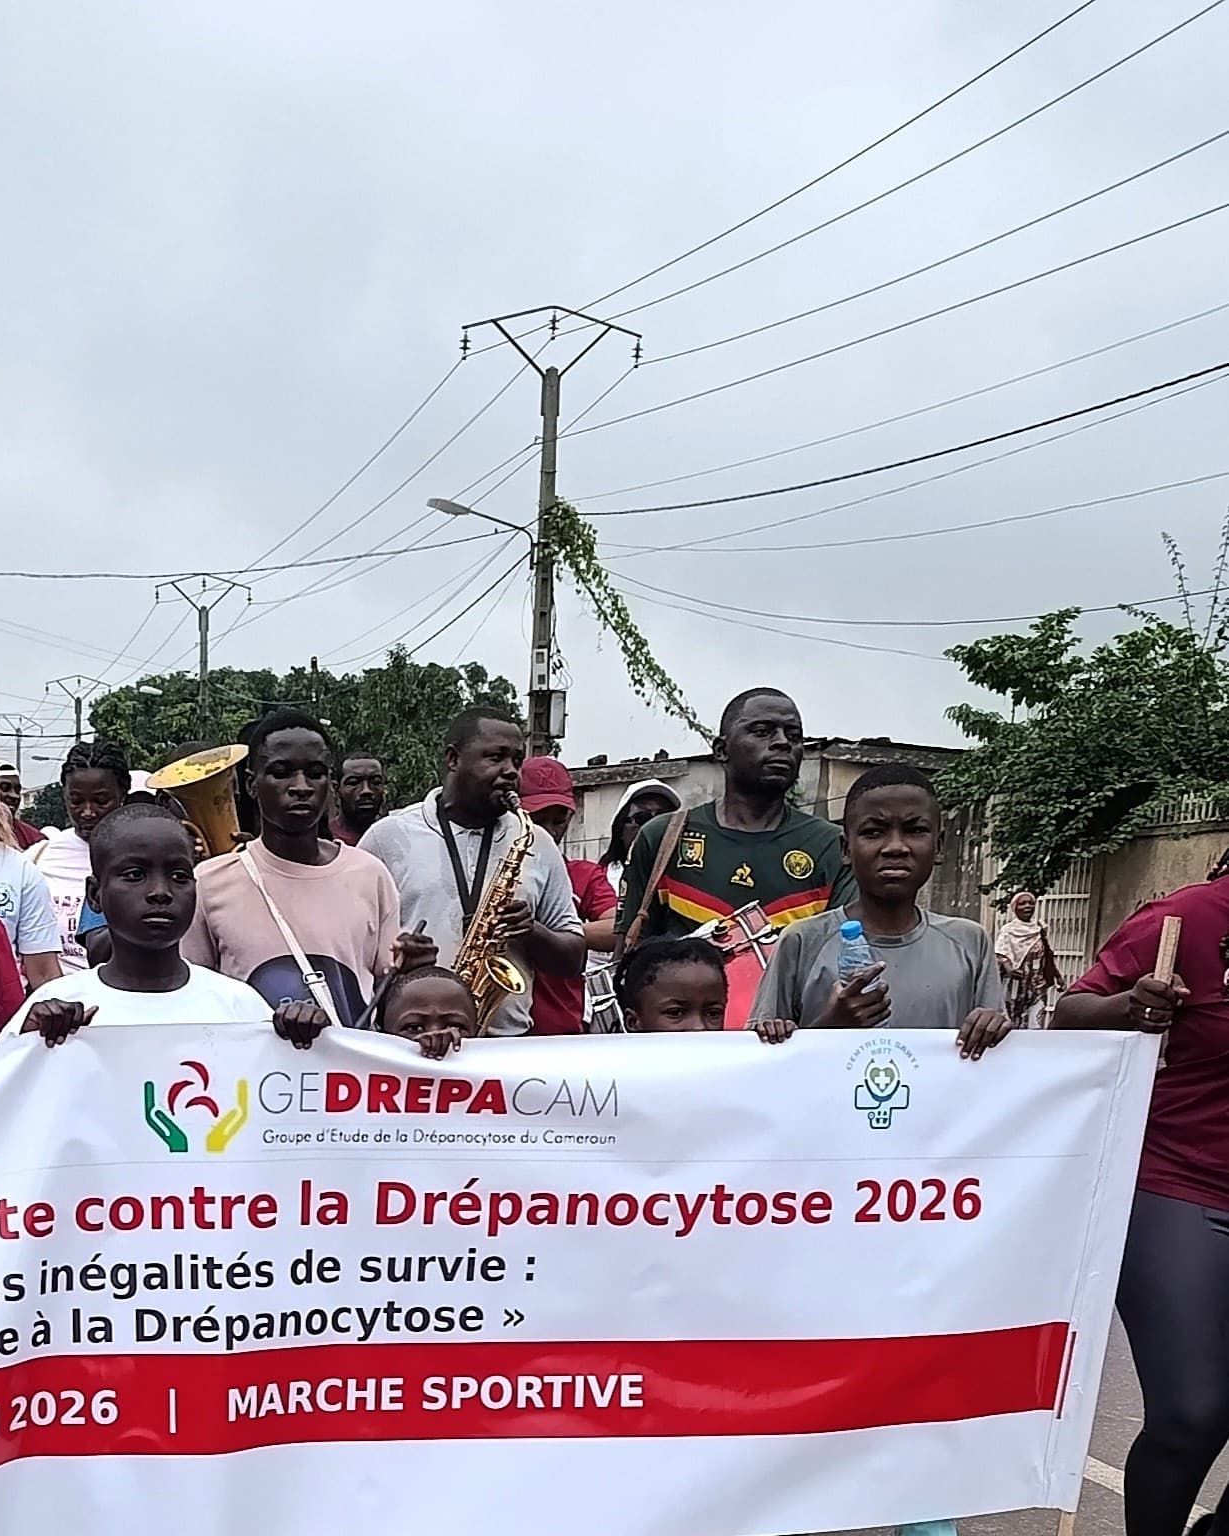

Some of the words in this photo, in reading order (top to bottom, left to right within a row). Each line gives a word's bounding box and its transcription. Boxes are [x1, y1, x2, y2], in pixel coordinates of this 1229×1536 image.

[258, 1071, 619, 1117] GEDREPACAM
[262, 1129, 312, 1146] Groupe
[373, 1127, 391, 1145] de
[395, 1128, 409, 1145] la
[520, 1127, 538, 1145] du
[543, 1129, 617, 1146] Cameroun
[75, 1185, 279, 1232] contre
[300, 1180, 349, 1227] la
[375, 1177, 834, 1238] Drépanocytose
[855, 1177, 983, 1223] 2026
[39, 1253, 274, 1300] inégalités
[290, 1248, 342, 1286] de
[359, 1247, 507, 1284] survie
[31, 1311, 52, 1348] à
[72, 1308, 113, 1344] la
[135, 1298, 485, 1351] Drépanocytose
[9, 1389, 118, 1431] 2026
[227, 1377, 404, 1422] MARCHE
[421, 1374, 645, 1411] SPORTIVE
